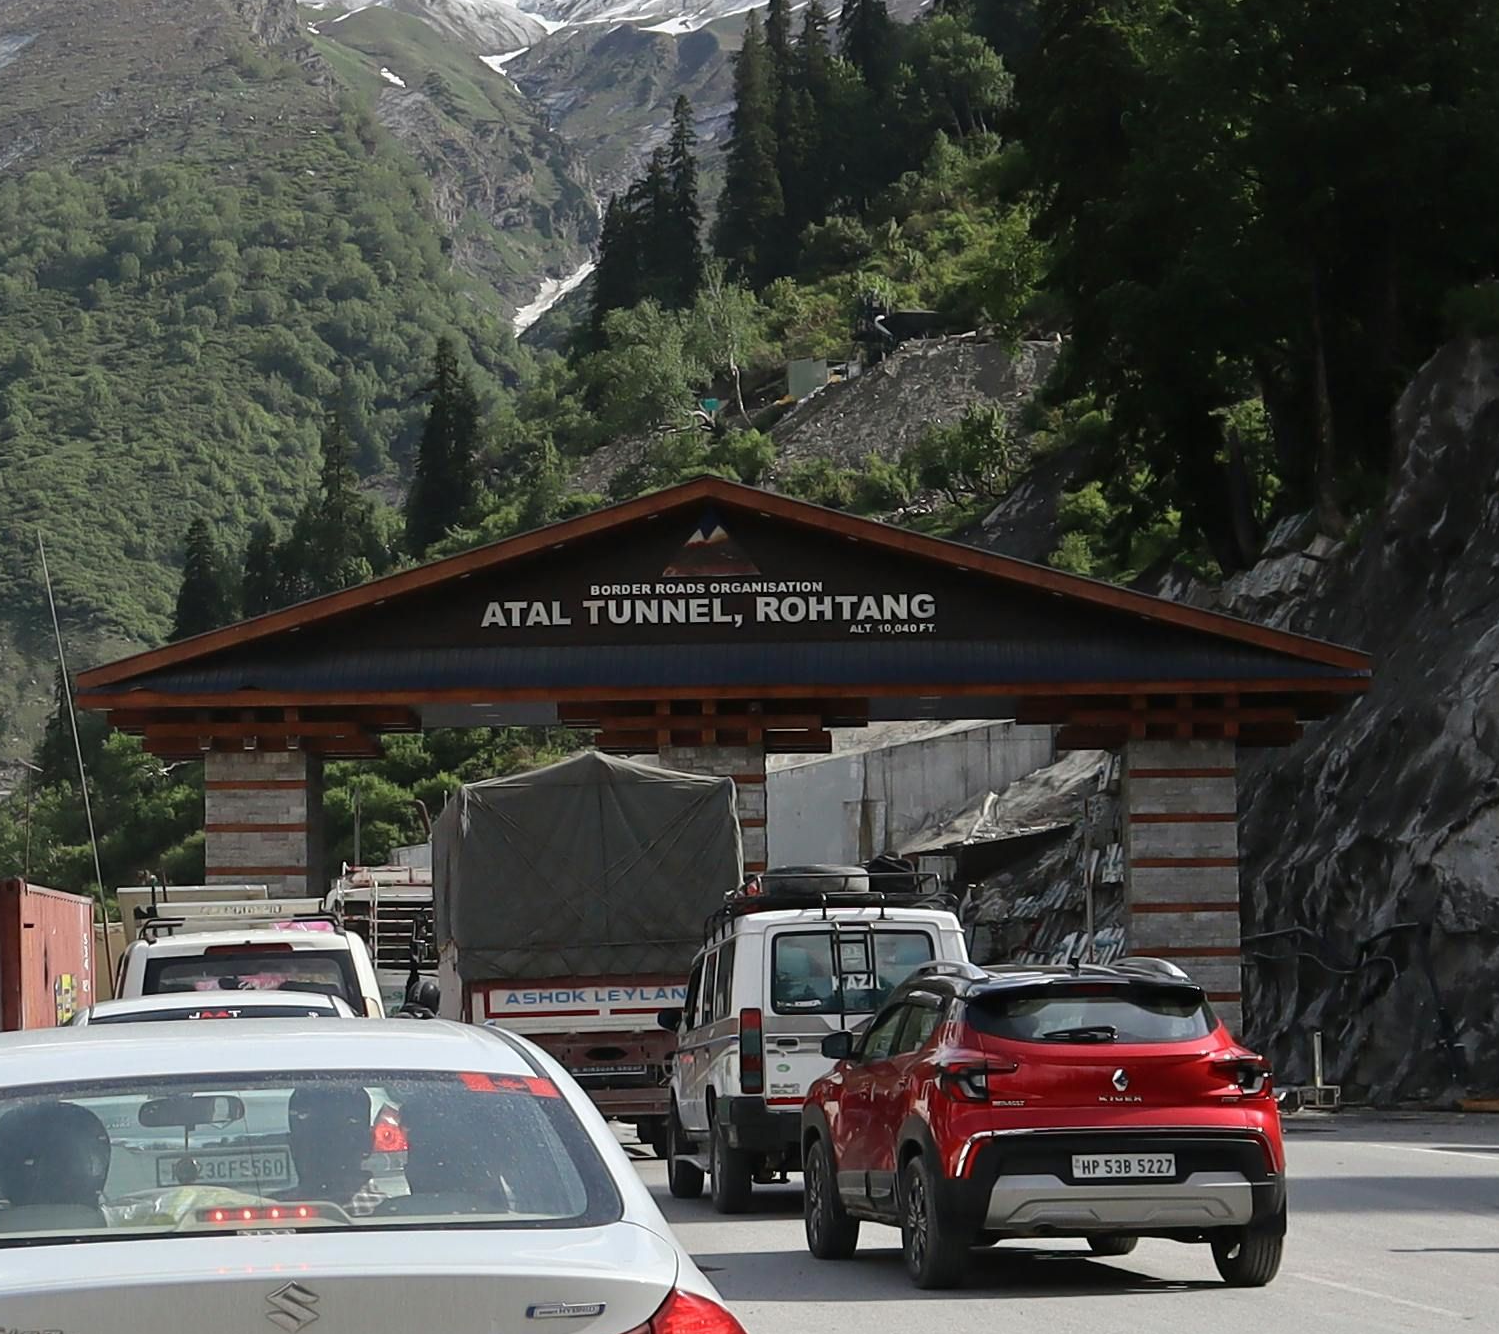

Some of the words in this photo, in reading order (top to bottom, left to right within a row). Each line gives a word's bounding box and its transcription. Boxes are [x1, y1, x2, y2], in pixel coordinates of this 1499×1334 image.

[590, 584, 651, 596] BORDER
[655, 583, 706, 595] ROADS
[709, 581, 823, 594] ORGANISATION
[480, 600, 572, 627] ATAL
[582, 597, 743, 627] TUNNEL,
[756, 593, 936, 623] ROHTANG
[505, 990, 587, 1005] ASHOK
[594, 987, 687, 1003] LEYLAN
[1082, 1160, 1100, 1174] HP
[1104, 1159, 1131, 1174] 53B
[1137, 1159, 1172, 1174] 5227
